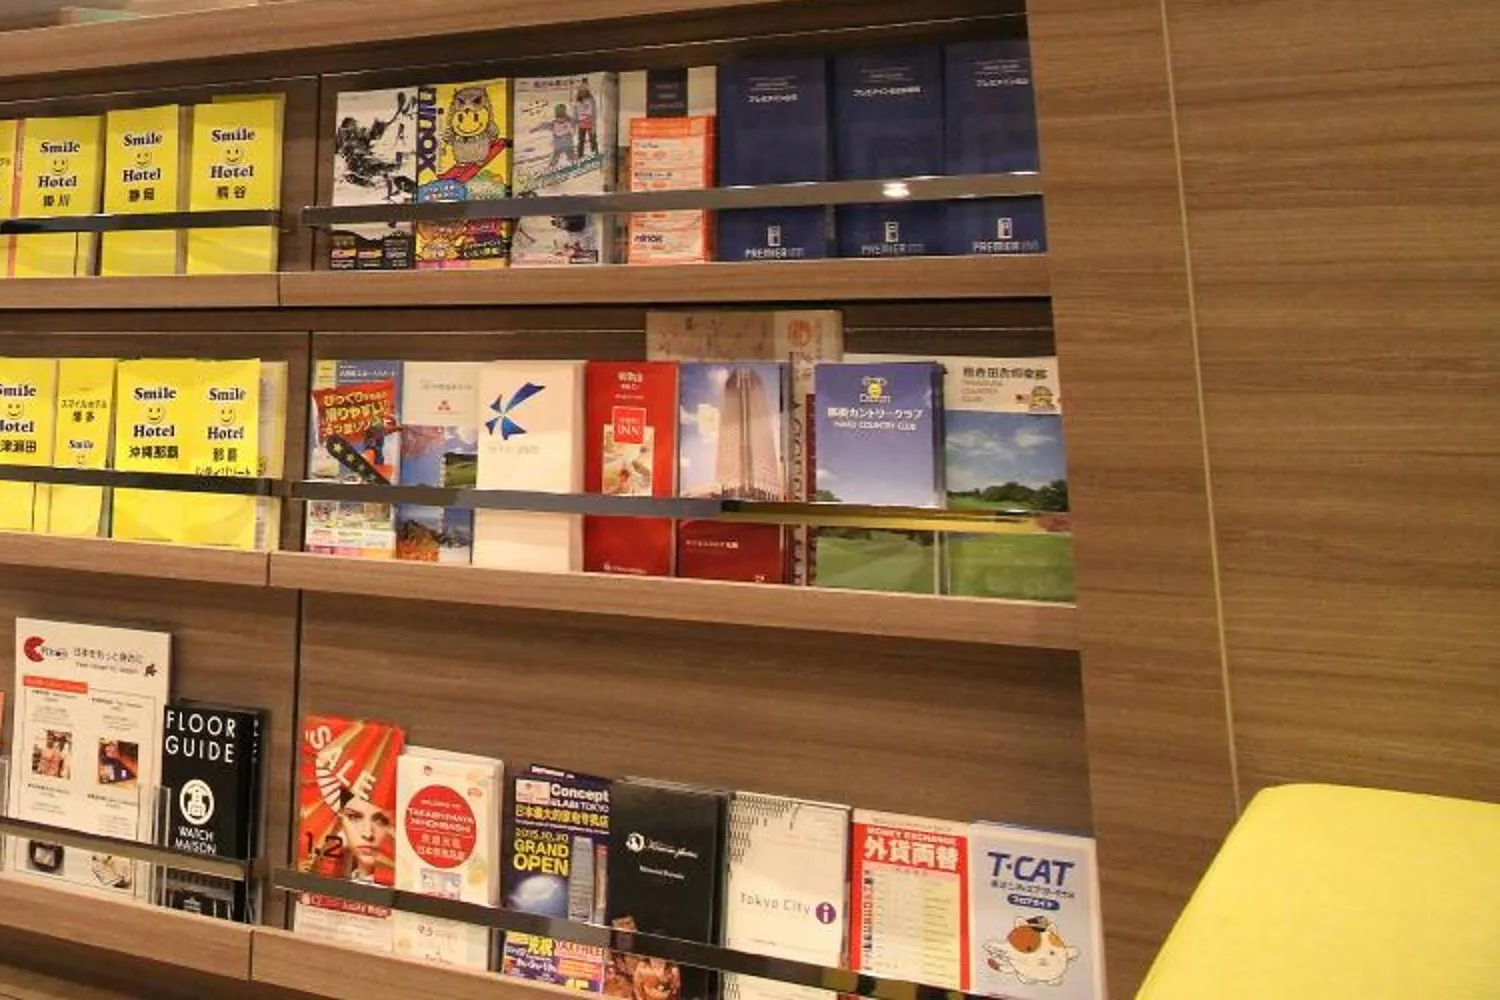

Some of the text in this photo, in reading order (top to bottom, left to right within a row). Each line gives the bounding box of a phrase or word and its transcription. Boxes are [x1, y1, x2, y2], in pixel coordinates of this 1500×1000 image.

[123, 131, 163, 147] Smile
[211, 128, 255, 143] Smile
[40, 142, 81, 153] Smile
[122, 168, 161, 182] Hotel
[211, 165, 254, 179] Hotel
[39, 176, 78, 188] Hotel
[133, 387, 177, 400] Smile
[208, 387, 246, 401] Smile
[132, 425, 175, 439] Hotel
[207, 426, 245, 440] Hotel
[165, 710, 237, 740] FLOOR
[164, 735, 235, 764] GUIDE
[551, 783, 610, 804] Concept
[178, 826, 215, 842] WATCH
[175, 839, 219, 856] MAISON
[514, 838, 570, 858] GRAND
[863, 835, 959, 870] 外貨両替
[513, 853, 569, 877] OPEN
[740, 891, 779, 911] Tokyo
[783, 898, 811, 917] City
